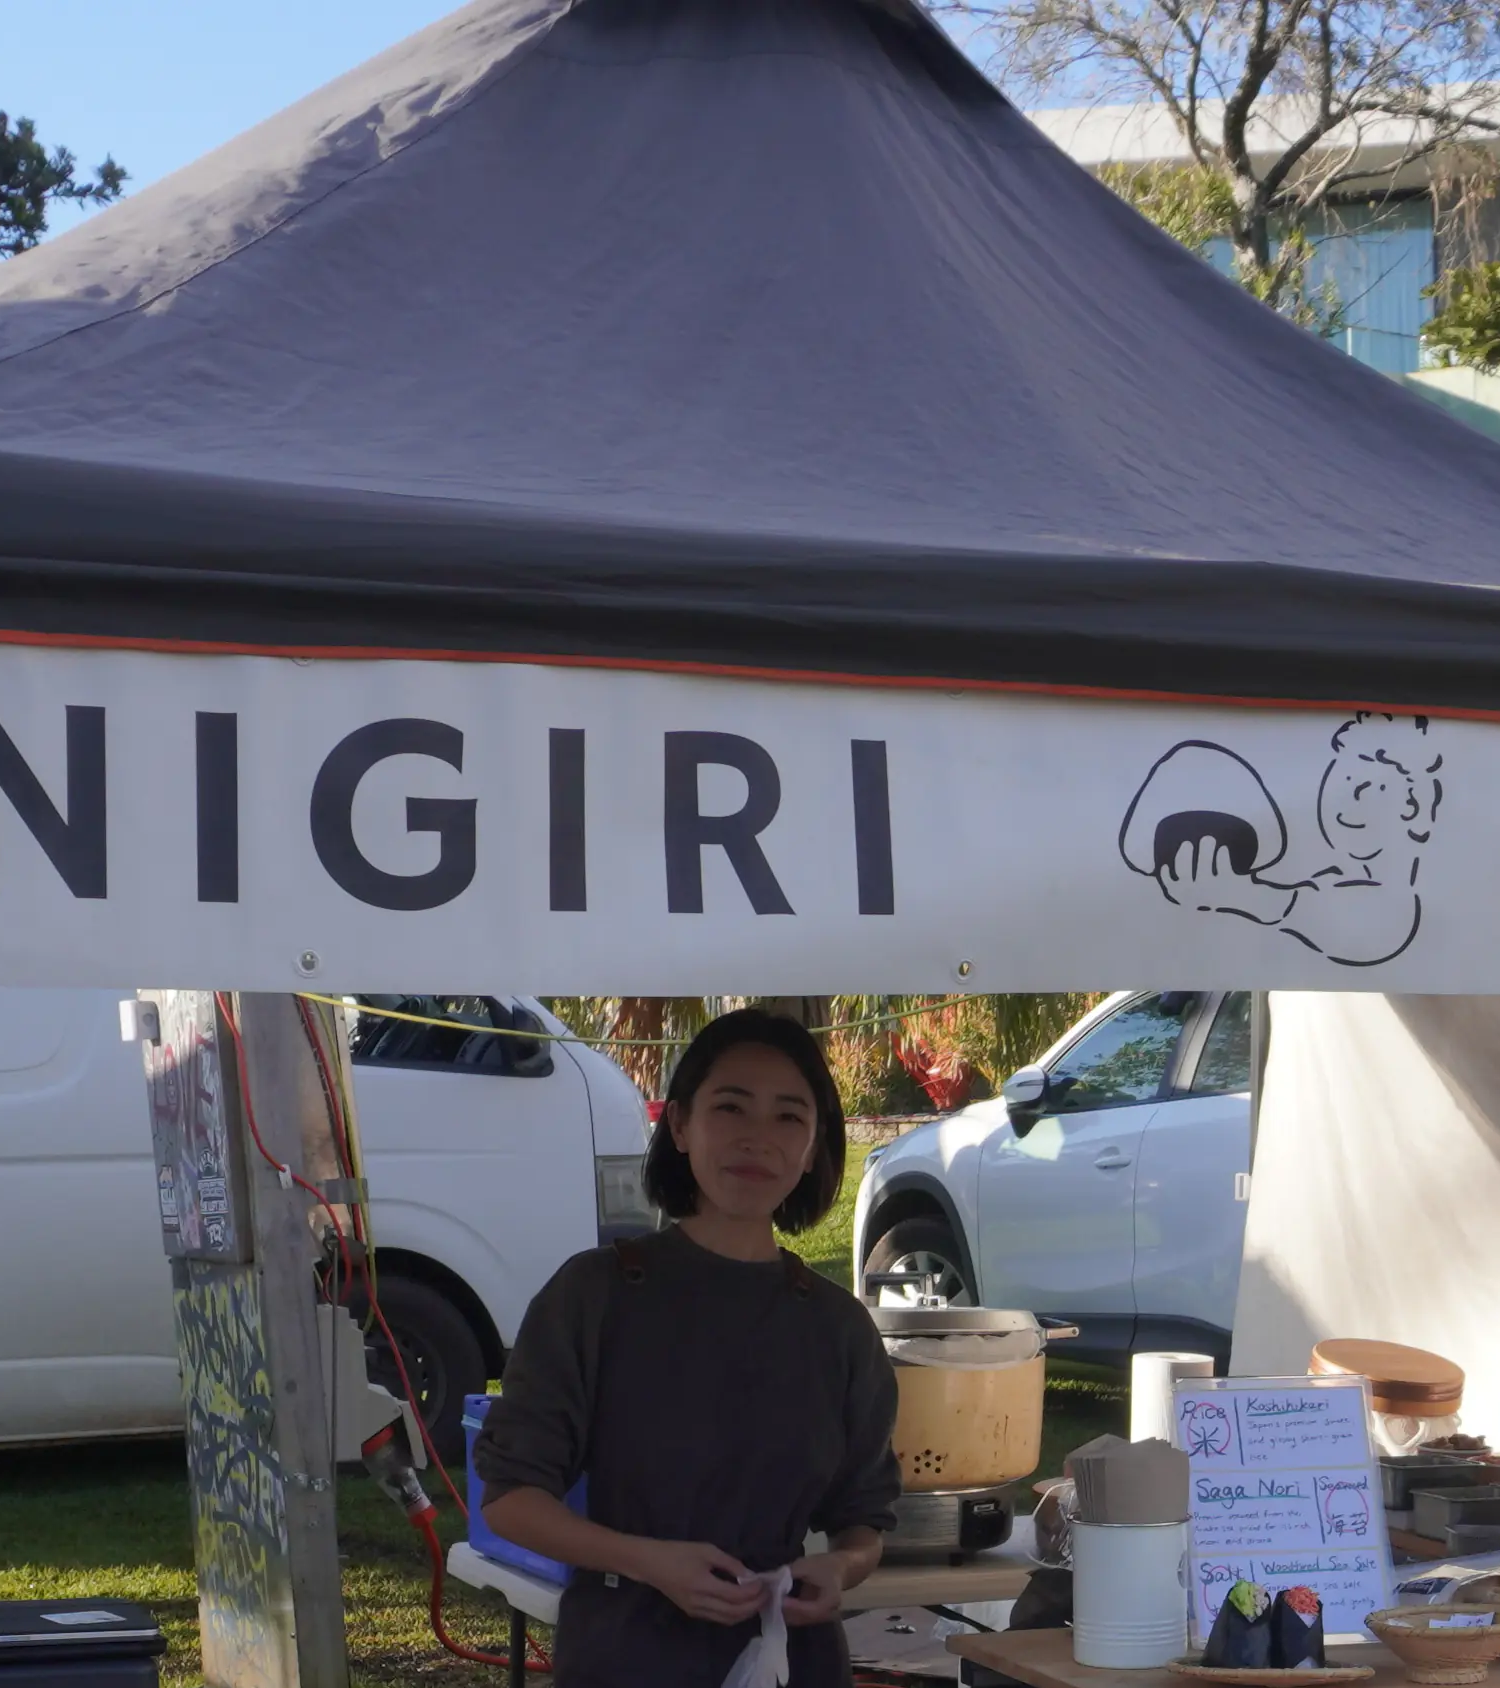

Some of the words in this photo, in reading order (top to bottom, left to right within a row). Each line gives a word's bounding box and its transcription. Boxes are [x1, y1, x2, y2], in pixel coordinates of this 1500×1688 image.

[1181, 1400, 1227, 1421] Rice
[1189, 1426, 1227, 1458] 米
[1196, 1478, 1248, 1509] Saga
[1258, 1478, 1300, 1498] Nori
[1200, 1562, 1244, 1584] Salt
